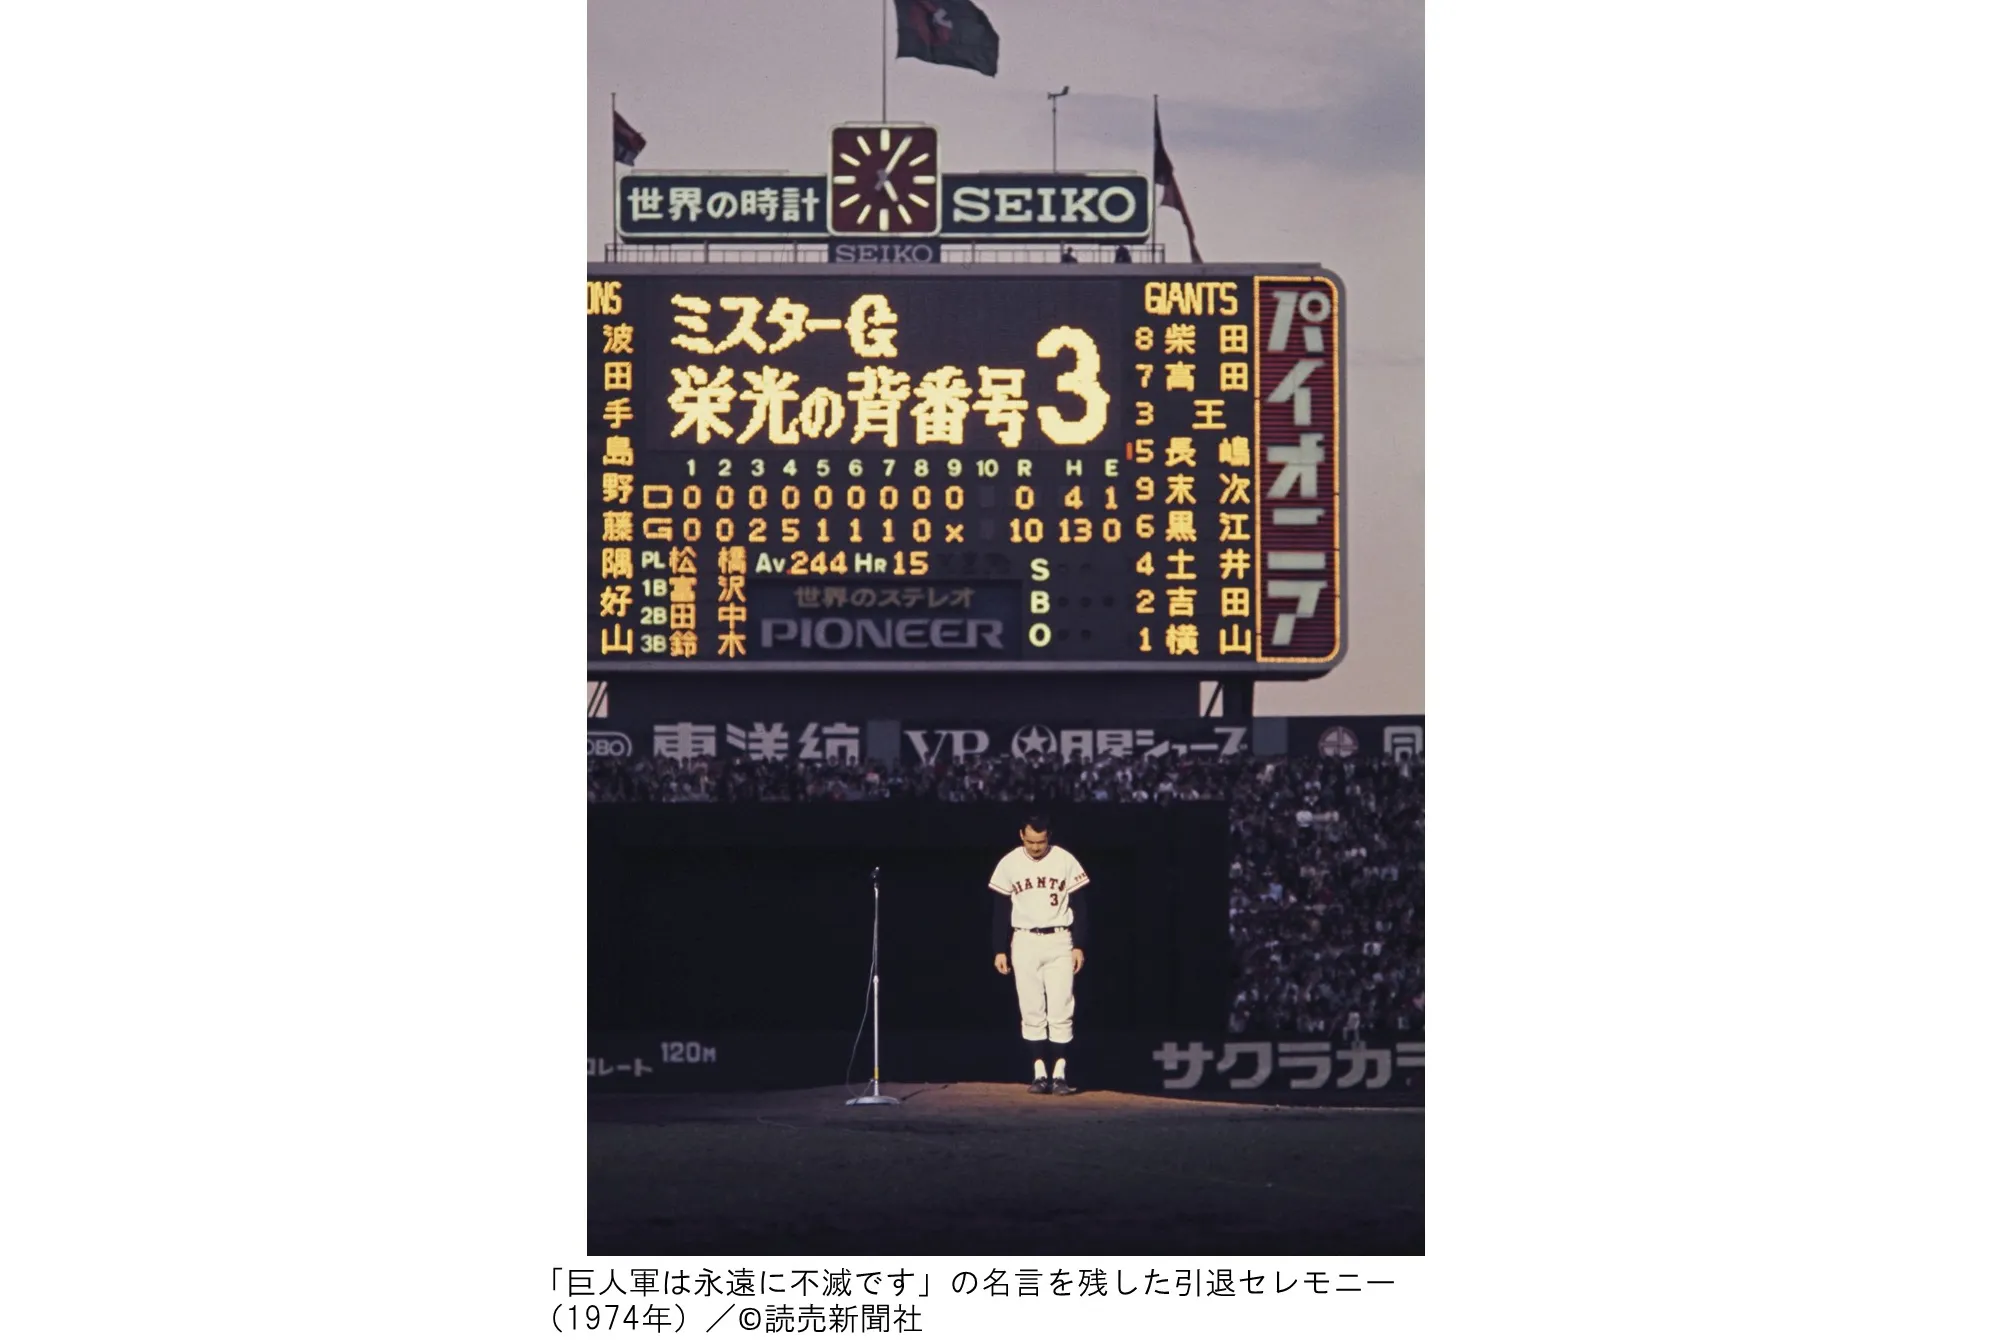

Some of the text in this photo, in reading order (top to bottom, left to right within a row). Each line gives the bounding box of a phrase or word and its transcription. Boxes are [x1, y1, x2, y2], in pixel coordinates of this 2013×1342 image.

[626, 185, 821, 224] 世界の時計
[952, 186, 1137, 224] SEIKO
[834, 244, 933, 264] SEIKO
[1145, 282, 1238, 315] GIANTS
[603, 323, 633, 353] 波
[671, 294, 898, 358] ミスターG
[1135, 323, 1248, 354] 8 柴田
[605, 362, 632, 391] 田
[667, 325, 1110, 448] 栄光の背番号 3
[1136, 361, 1248, 391] 7 高田
[603, 398, 633, 429] 手
[1136, 400, 1226, 429] 3 王
[603, 435, 634, 466] 島
[1136, 439, 1154, 463] 5
[687, 459, 1118, 477] 1 2 3 4 5 6 7 8 9 10 R H E
[1266, 291, 1331, 646] パイオニア
[603, 473, 634, 504] 野
[683, 485, 701, 509] 0
[716, 485, 734, 509] 0
[749, 485, 767, 509] 0
[782, 485, 800, 509] 0
[814, 485, 832, 509] 0
[847, 486, 865, 509] 0
[880, 486, 898, 510] 0
[913, 486, 931, 510] 0
[945, 486, 963, 510] 0
[1015, 486, 1034, 510] 0
[1065, 486, 1083, 509] 4
[1105, 486, 1118, 509] 1
[1136, 473, 1250, 504] 9 末次
[603, 511, 633, 541] 藤
[643, 518, 673, 541] G
[683, 518, 701, 541] 0
[716, 518, 734, 542] 0
[749, 518, 766, 542] 2
[782, 518, 800, 542] 5
[817, 518, 830, 542] 1
[850, 518, 862, 542] 1
[883, 519, 895, 542] 1
[913, 518, 931, 542] 0
[1010, 518, 1043, 543] 10
[1059, 518, 1092, 543] 13
[1103, 518, 1121, 542] 0
[1136, 510, 1250, 542] 6 黒江
[602, 548, 633, 579] 隅
[642, 551, 665, 568] PL
[894, 551, 928, 575] 15
[1031, 558, 1049, 581] S
[1136, 548, 1250, 579] 4 土井
[600, 585, 633, 617] 好
[643, 579, 667, 596] 1B
[794, 586, 976, 608] 世界のステレオ
[1031, 591, 1050, 613] B
[1136, 586, 1249, 617] 2 吉田
[641, 602, 746, 629] 2B 田中
[602, 623, 633, 654] 山
[642, 635, 666, 652] 3B
[761, 617, 1004, 649] PIONEER
[1029, 623, 1051, 647] O
[1140, 624, 1251, 655] 1 横山
[904, 730, 990, 766] VP
[1050, 893, 1059, 906] 3
[660, 1041, 716, 1063] 120M
